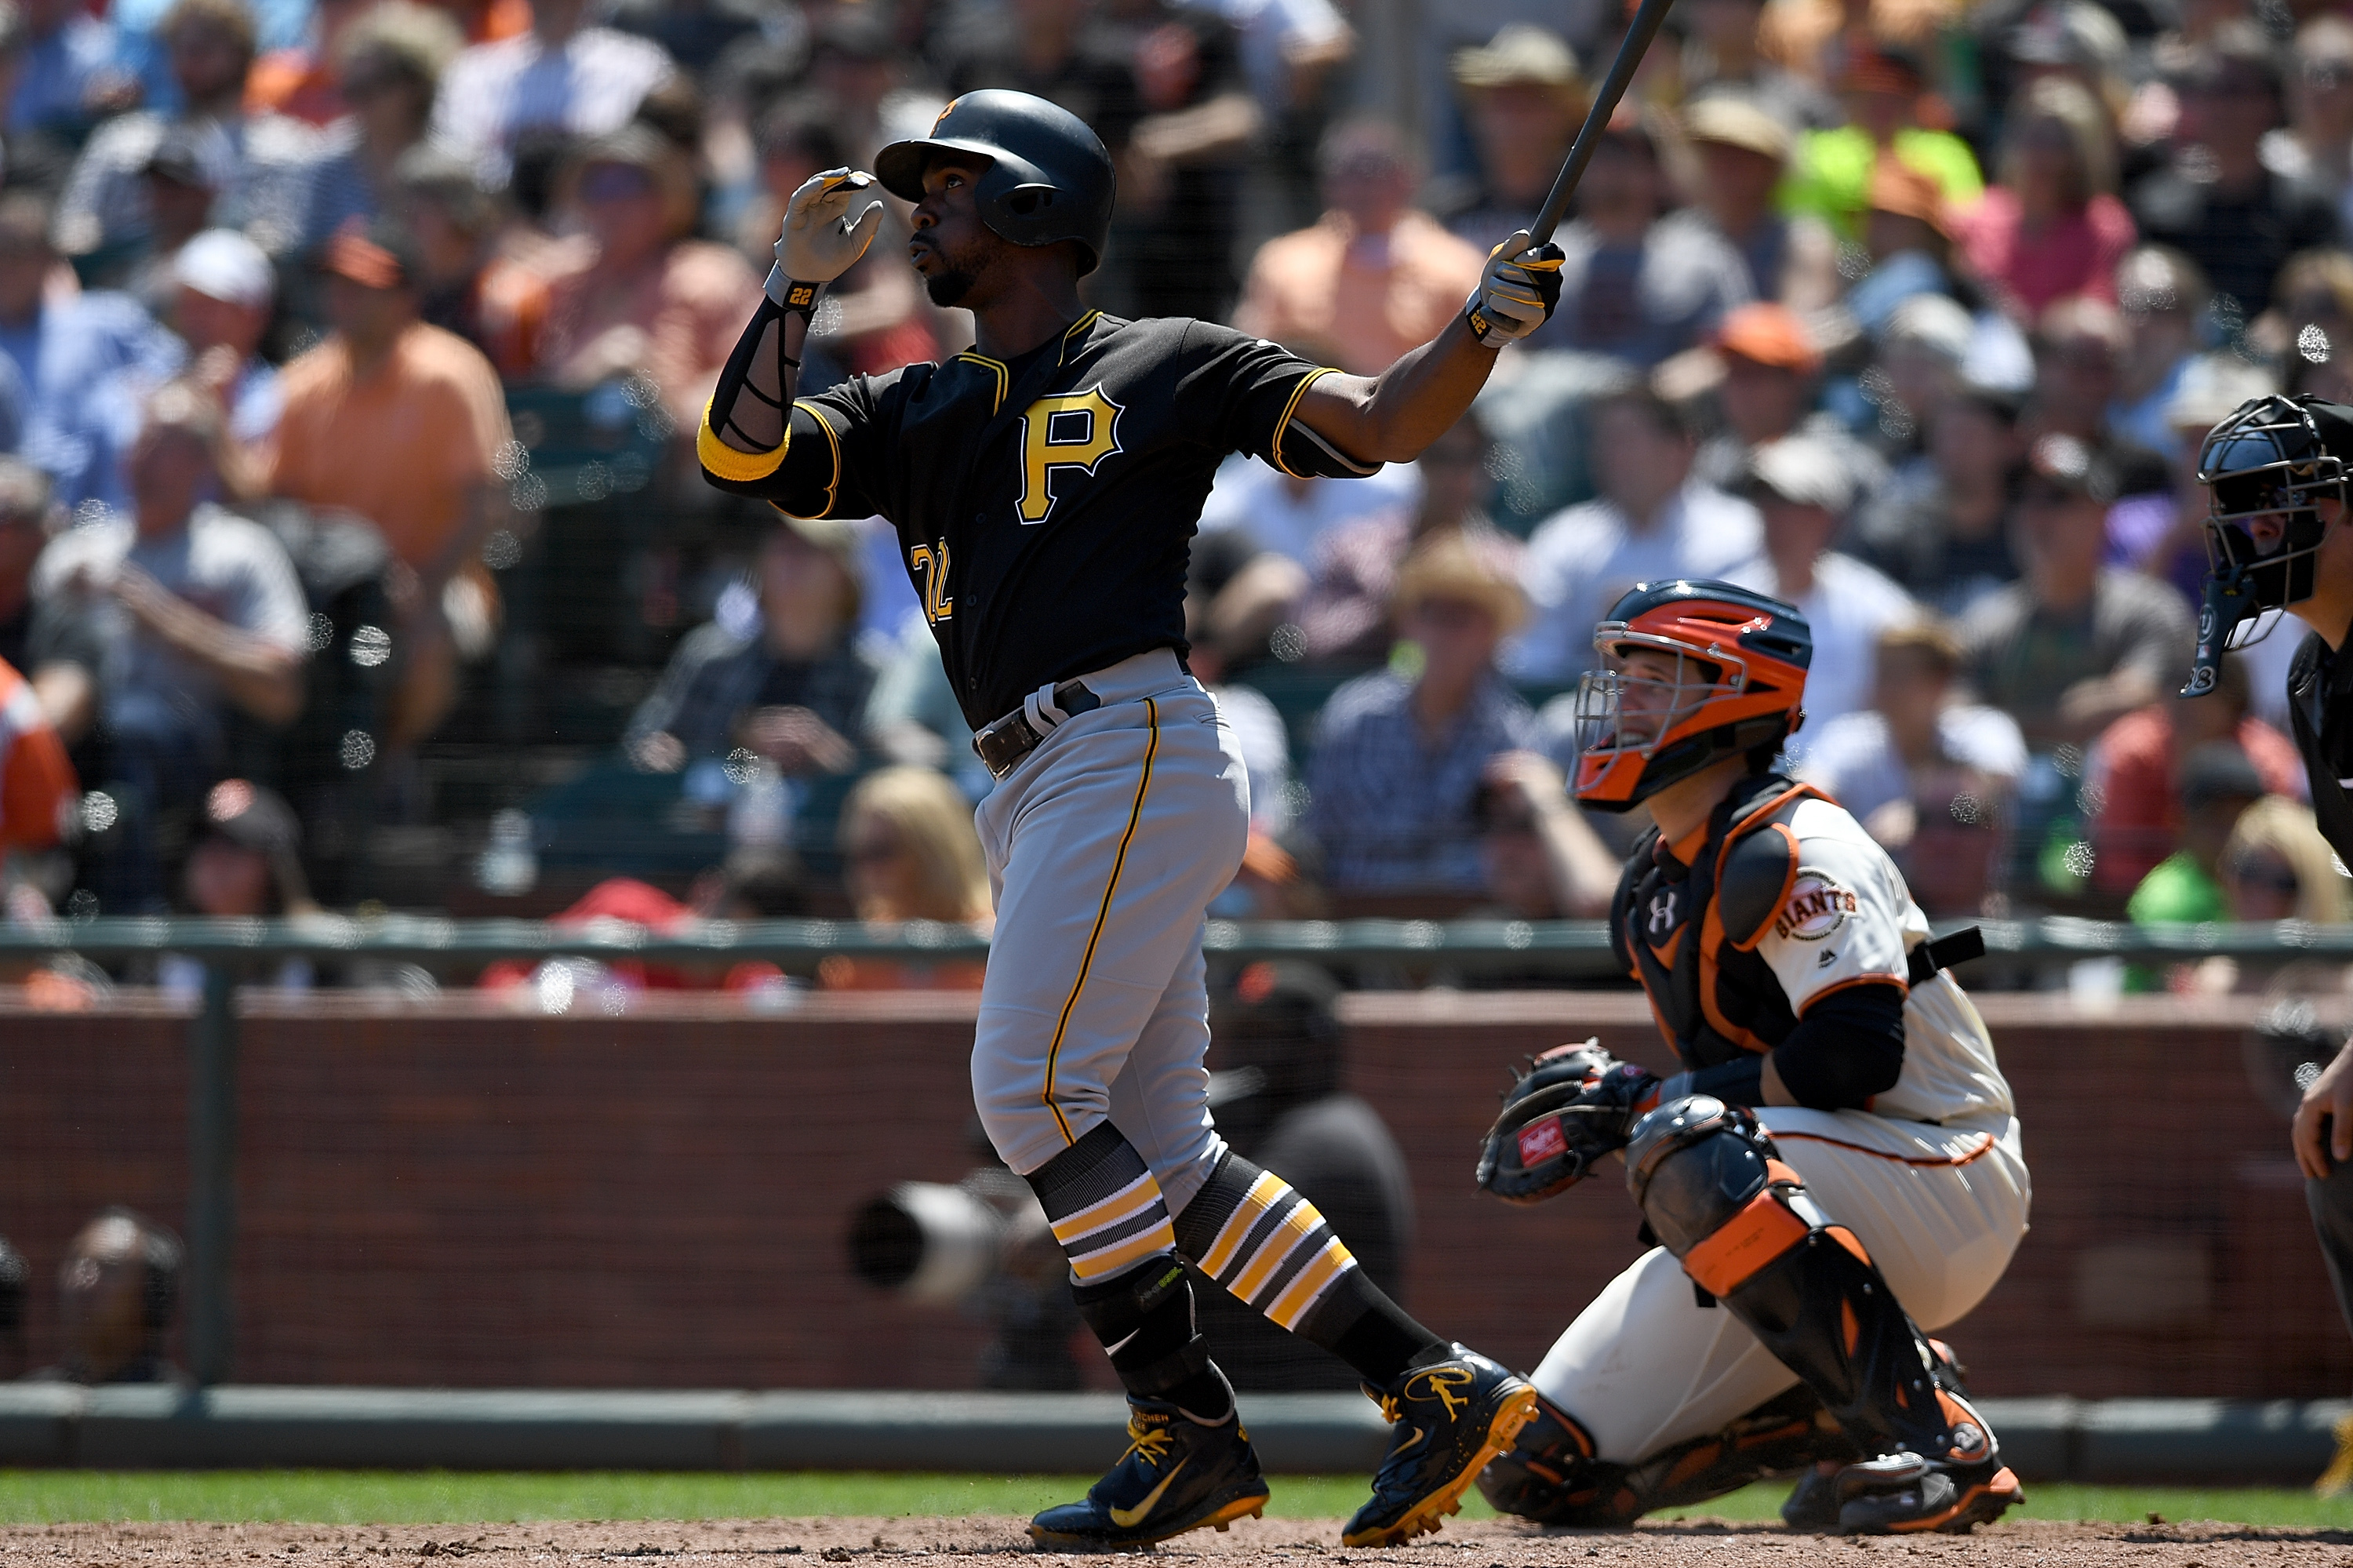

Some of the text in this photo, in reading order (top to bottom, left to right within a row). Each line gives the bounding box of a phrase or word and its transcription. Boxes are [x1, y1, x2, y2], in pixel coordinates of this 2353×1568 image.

[789, 287, 813, 305] 22
[1471, 309, 1487, 335] 22
[1015, 381, 1126, 526] P
